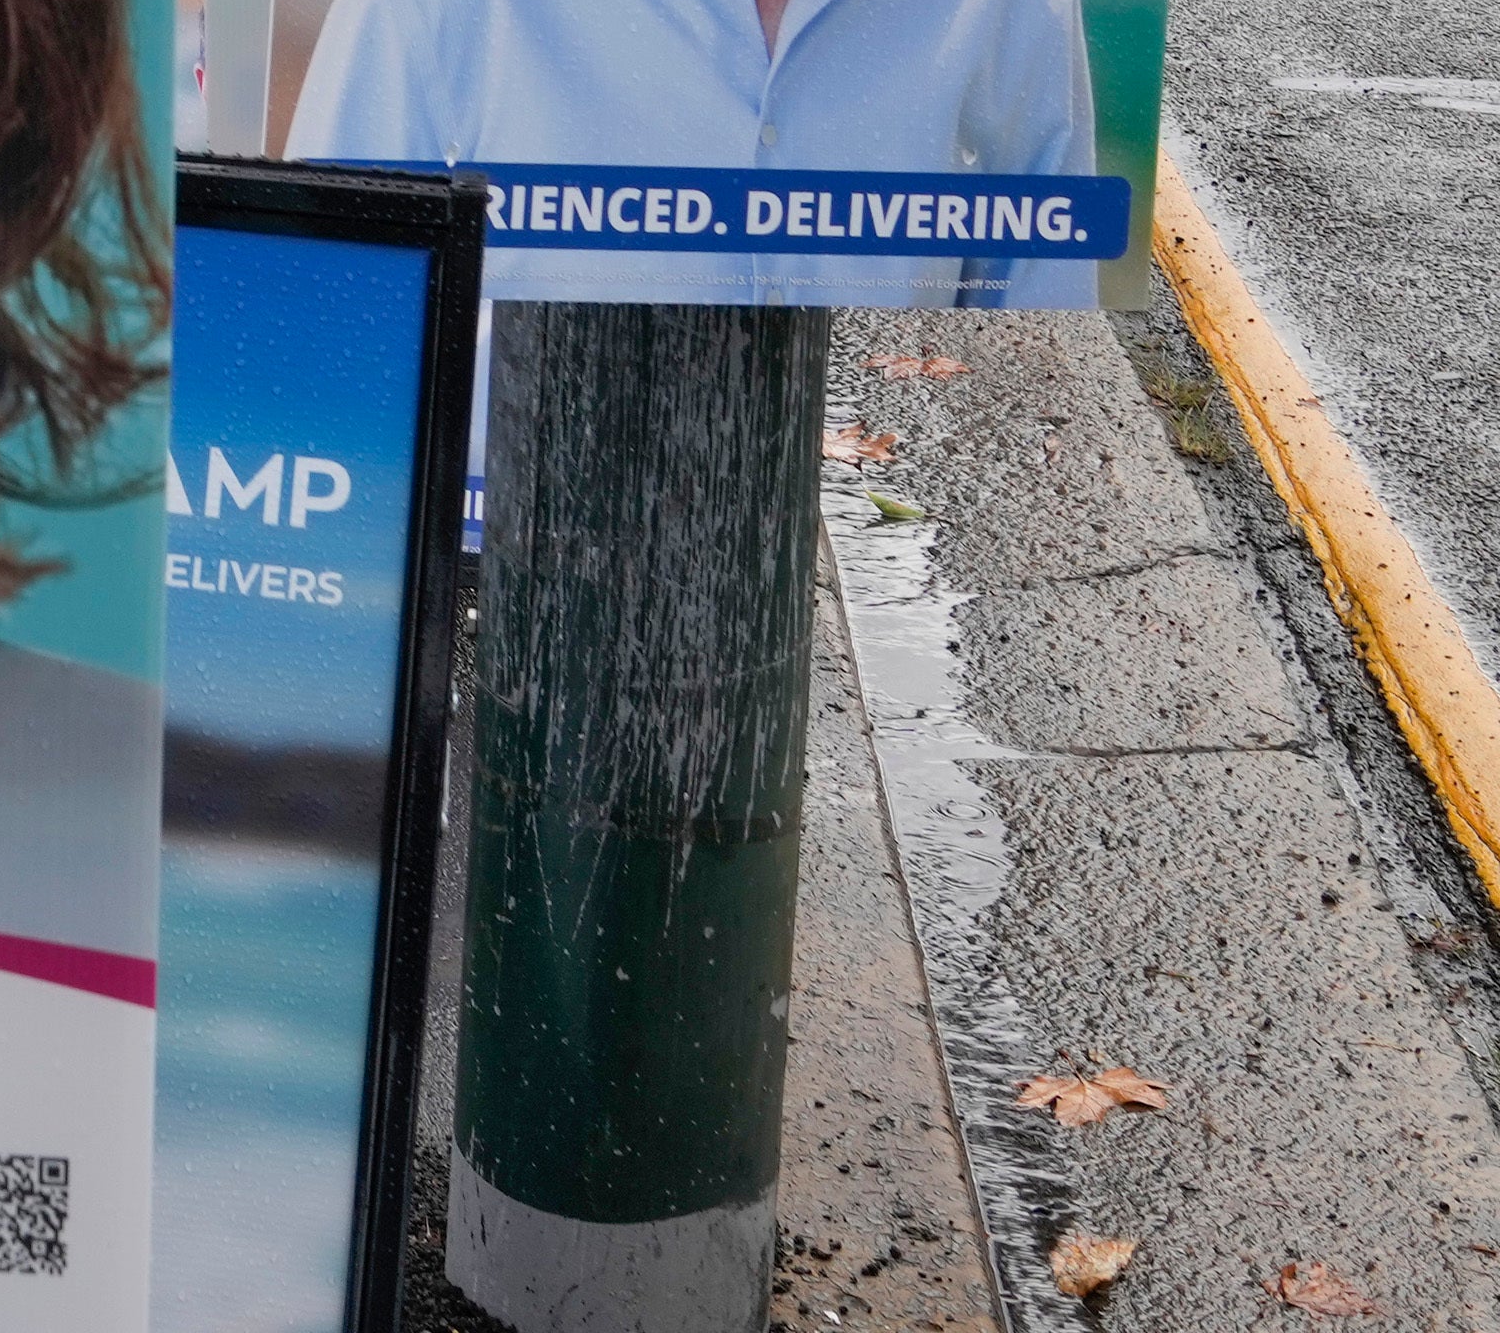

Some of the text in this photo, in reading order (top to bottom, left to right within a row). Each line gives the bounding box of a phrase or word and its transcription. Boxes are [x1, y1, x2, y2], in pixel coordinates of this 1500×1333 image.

[746, 190, 1088, 243] DELIVERING.
[909, 280, 933, 289] NSW
[937, 279, 983, 291] Edgecliff
[985, 280, 1011, 290] 2027
